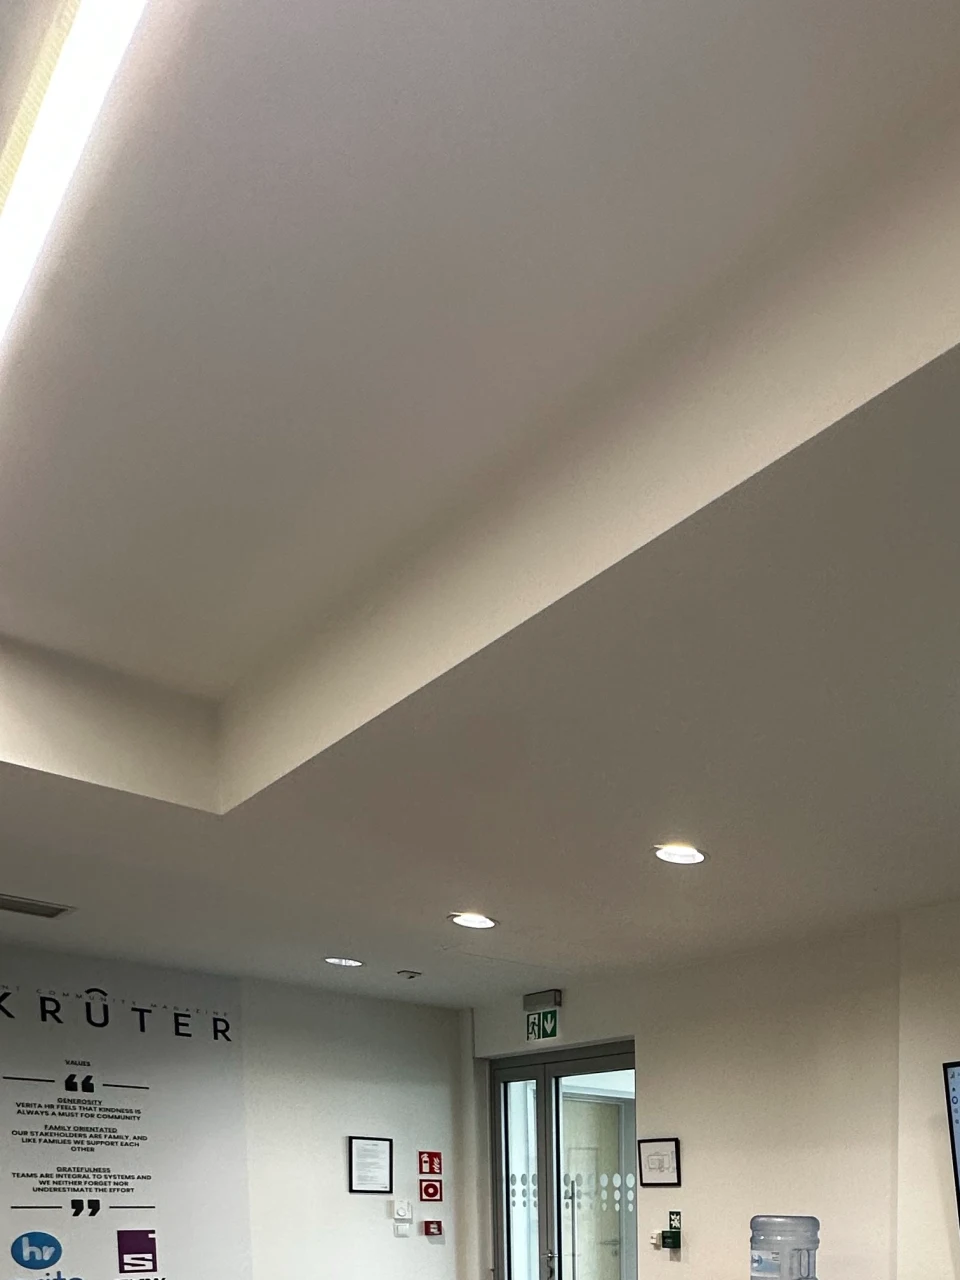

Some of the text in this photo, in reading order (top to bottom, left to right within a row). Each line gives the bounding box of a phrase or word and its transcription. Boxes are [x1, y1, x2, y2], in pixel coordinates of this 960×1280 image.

[64, 1059, 91, 1067] VALUES
[57, 1097, 103, 1106] GENEROSITY
[56, 1103, 77, 1111] FEELS
[98, 1106, 134, 1115] KINDNESS
[16, 1109, 50, 1117] ALWAYS
[96, 1113, 142, 1121] COMMUNITY
[44, 1124, 118, 1134] FAMILY ORIENTATED
[30, 1130, 88, 1139] STAKEHOLDERS
[86, 1139, 119, 1147] SUPPORT
[56, 1166, 111, 1174] GRATEFULNESS
